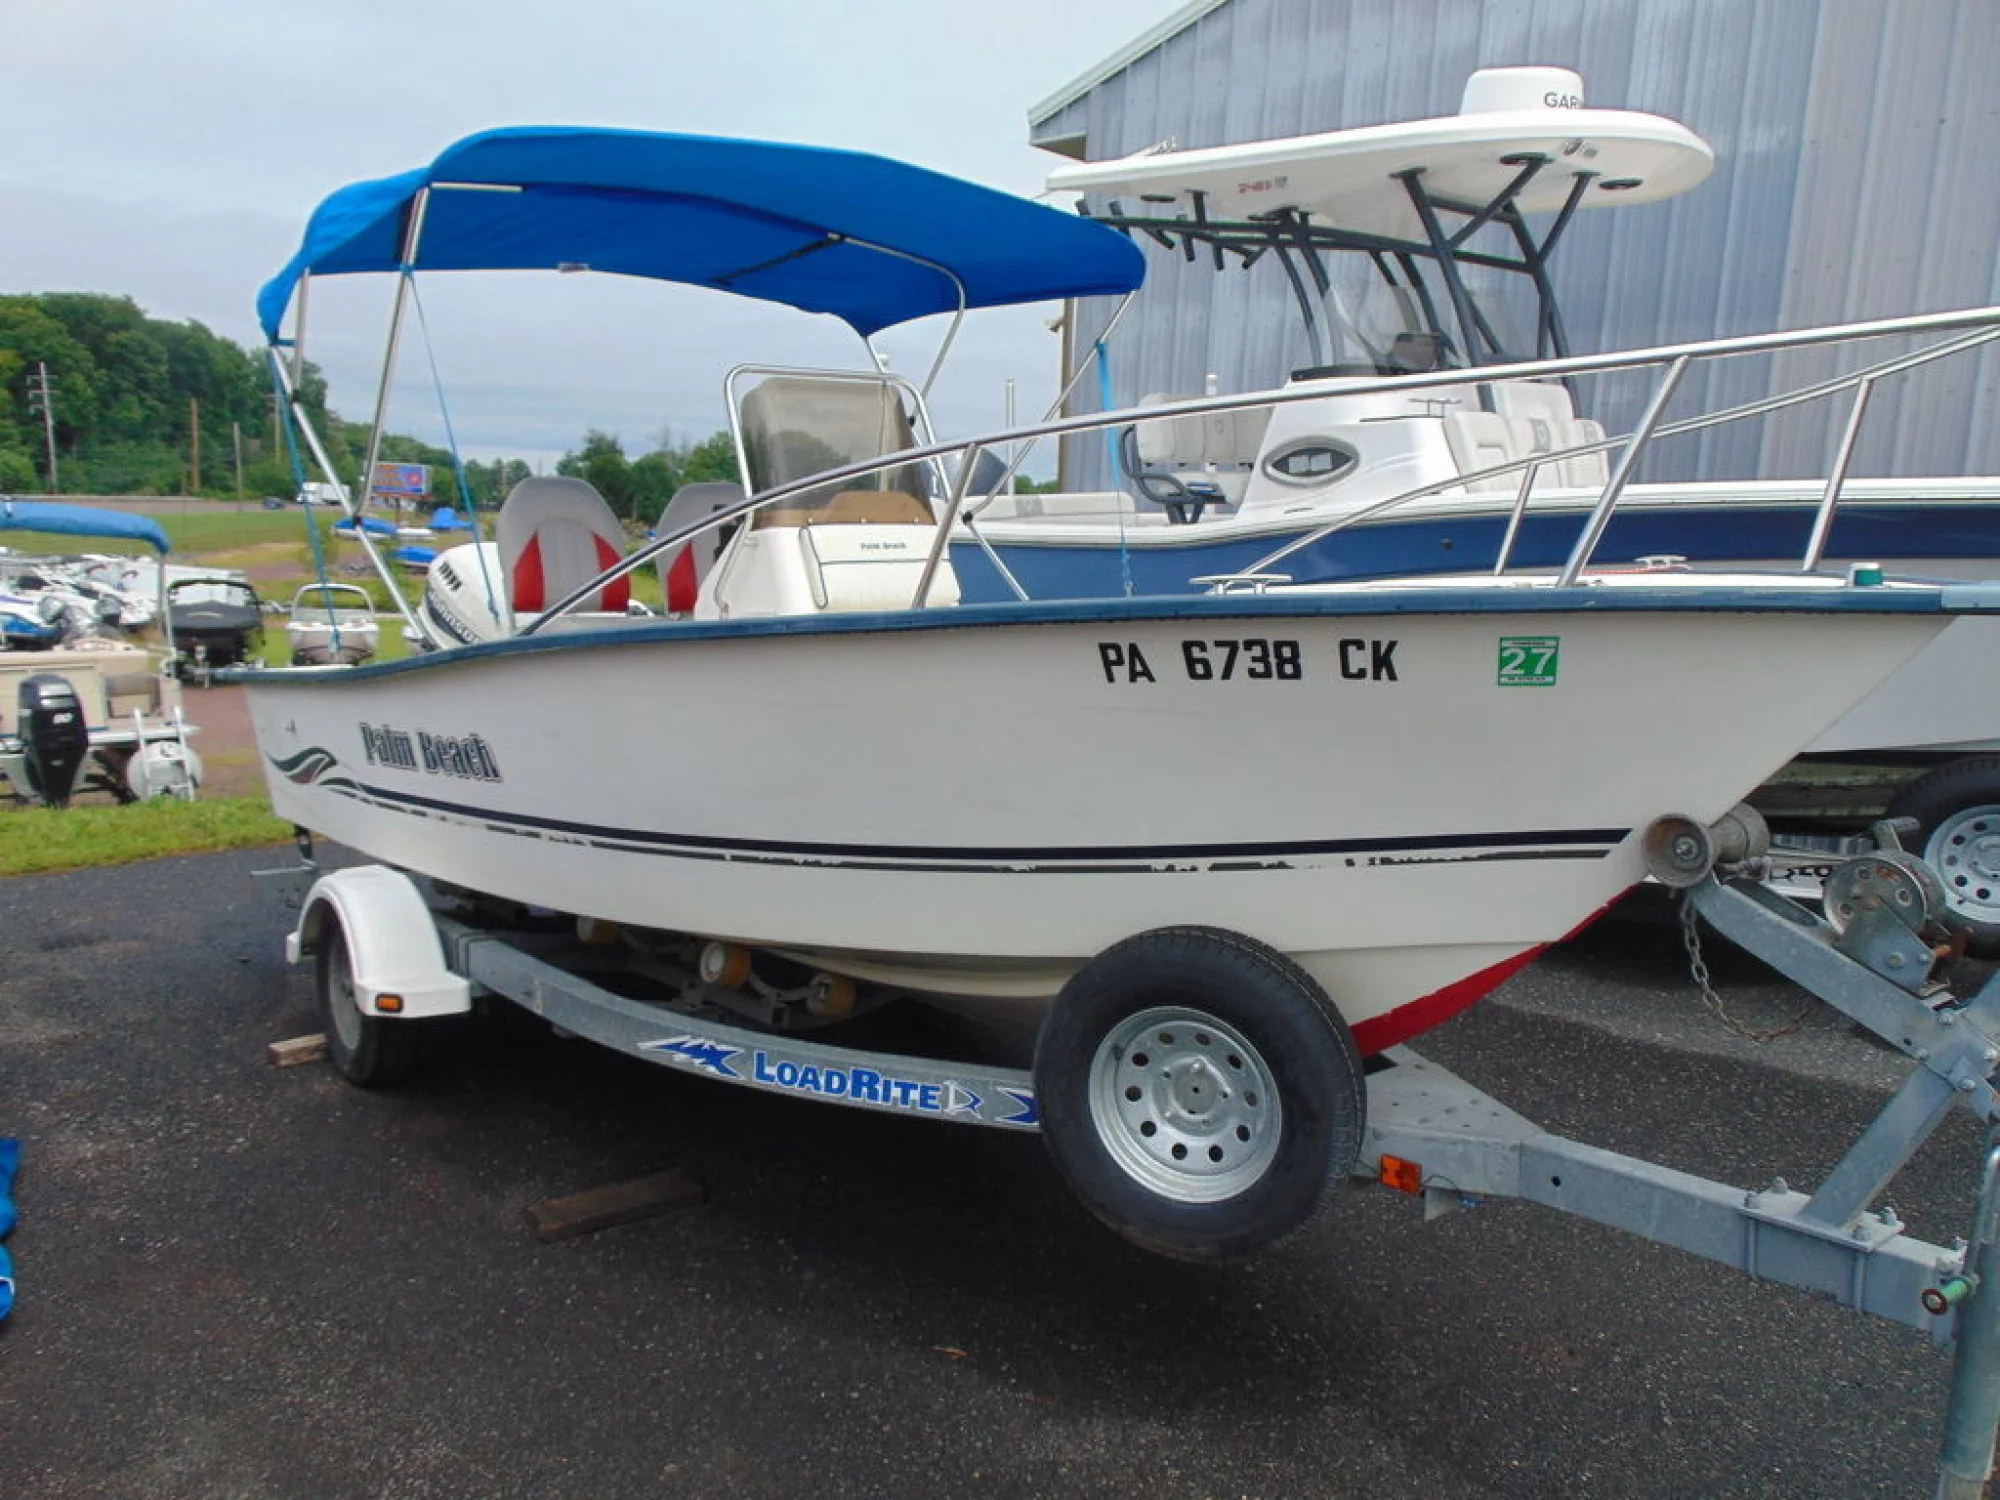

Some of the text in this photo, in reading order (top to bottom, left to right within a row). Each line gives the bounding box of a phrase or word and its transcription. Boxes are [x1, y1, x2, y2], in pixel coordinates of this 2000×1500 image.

[1098, 638, 1399, 683] PA 6738 CK
[1500, 647, 1556, 675] 27
[359, 721, 503, 783] Palm Beach
